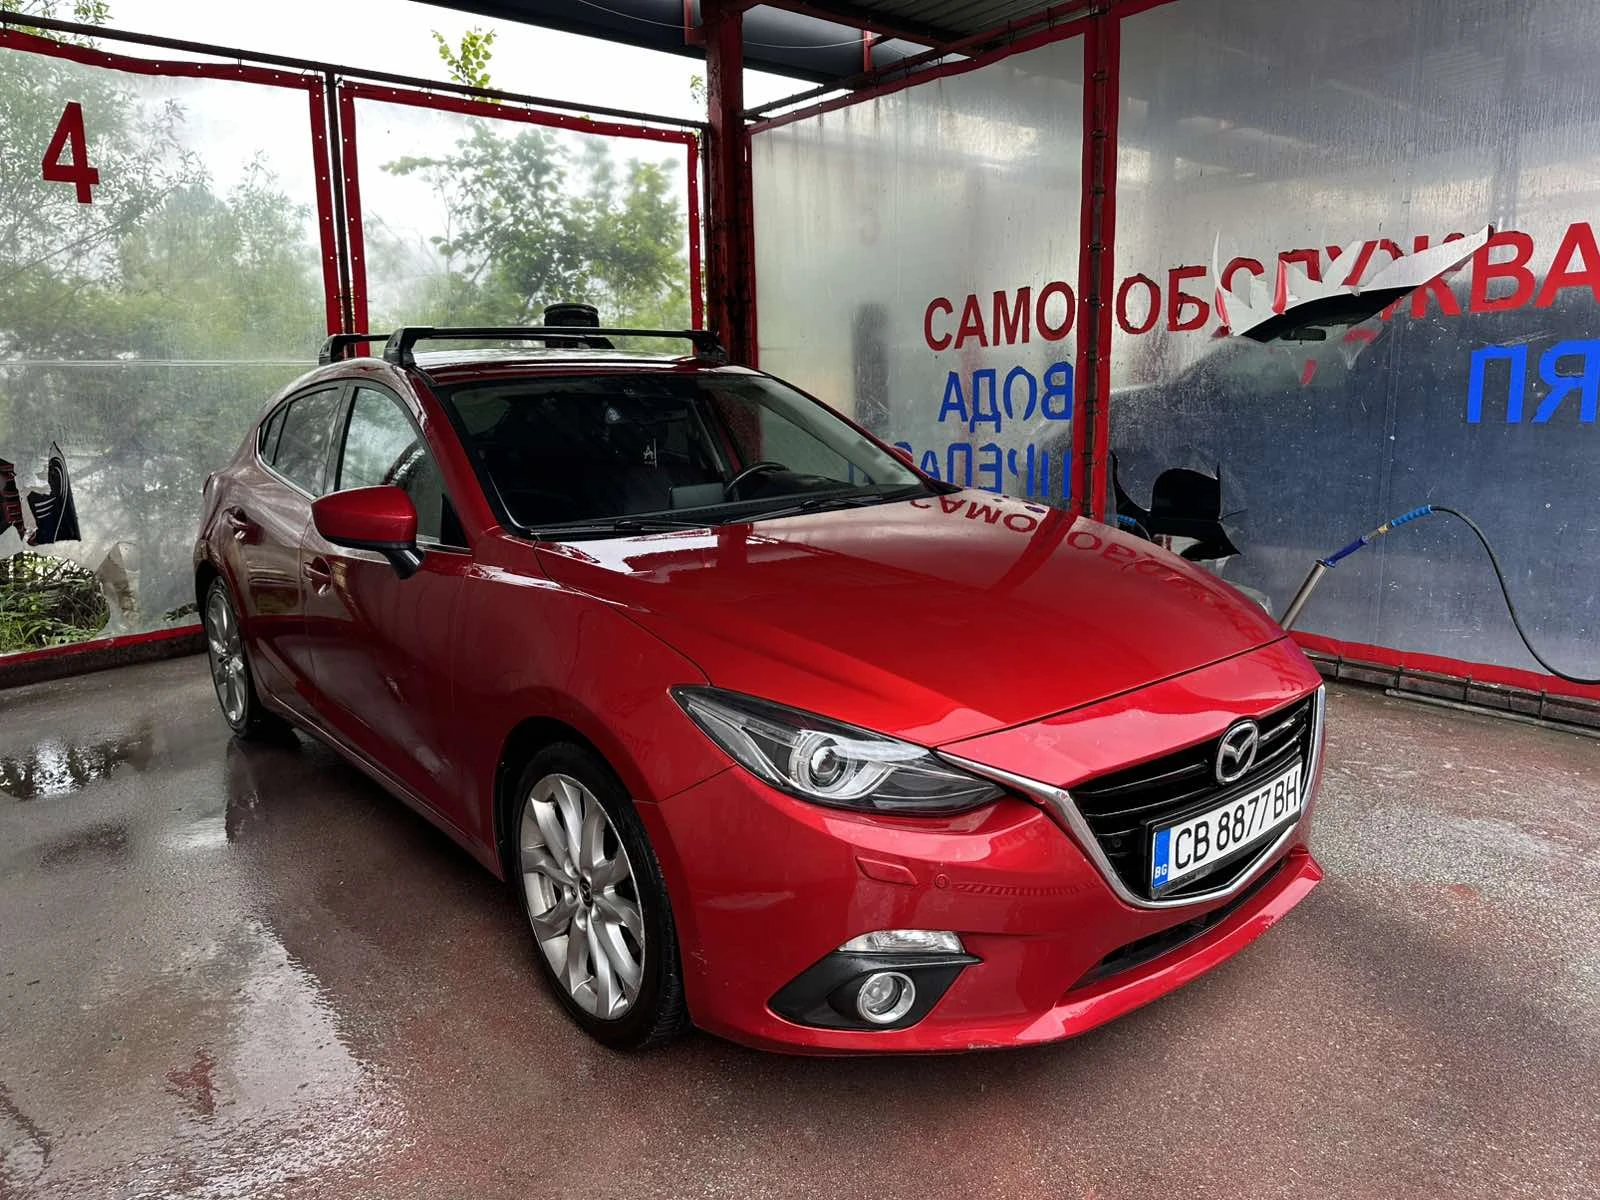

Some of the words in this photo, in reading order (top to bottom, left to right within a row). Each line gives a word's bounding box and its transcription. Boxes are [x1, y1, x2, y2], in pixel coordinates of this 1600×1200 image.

[42, 102, 99, 204] 4
[924, 281, 1075, 351] САМО
[1175, 821, 1210, 869] CB
[1216, 788, 1271, 851] 8877
[1274, 771, 1298, 820] BH
[1155, 864, 1168, 879] BG
